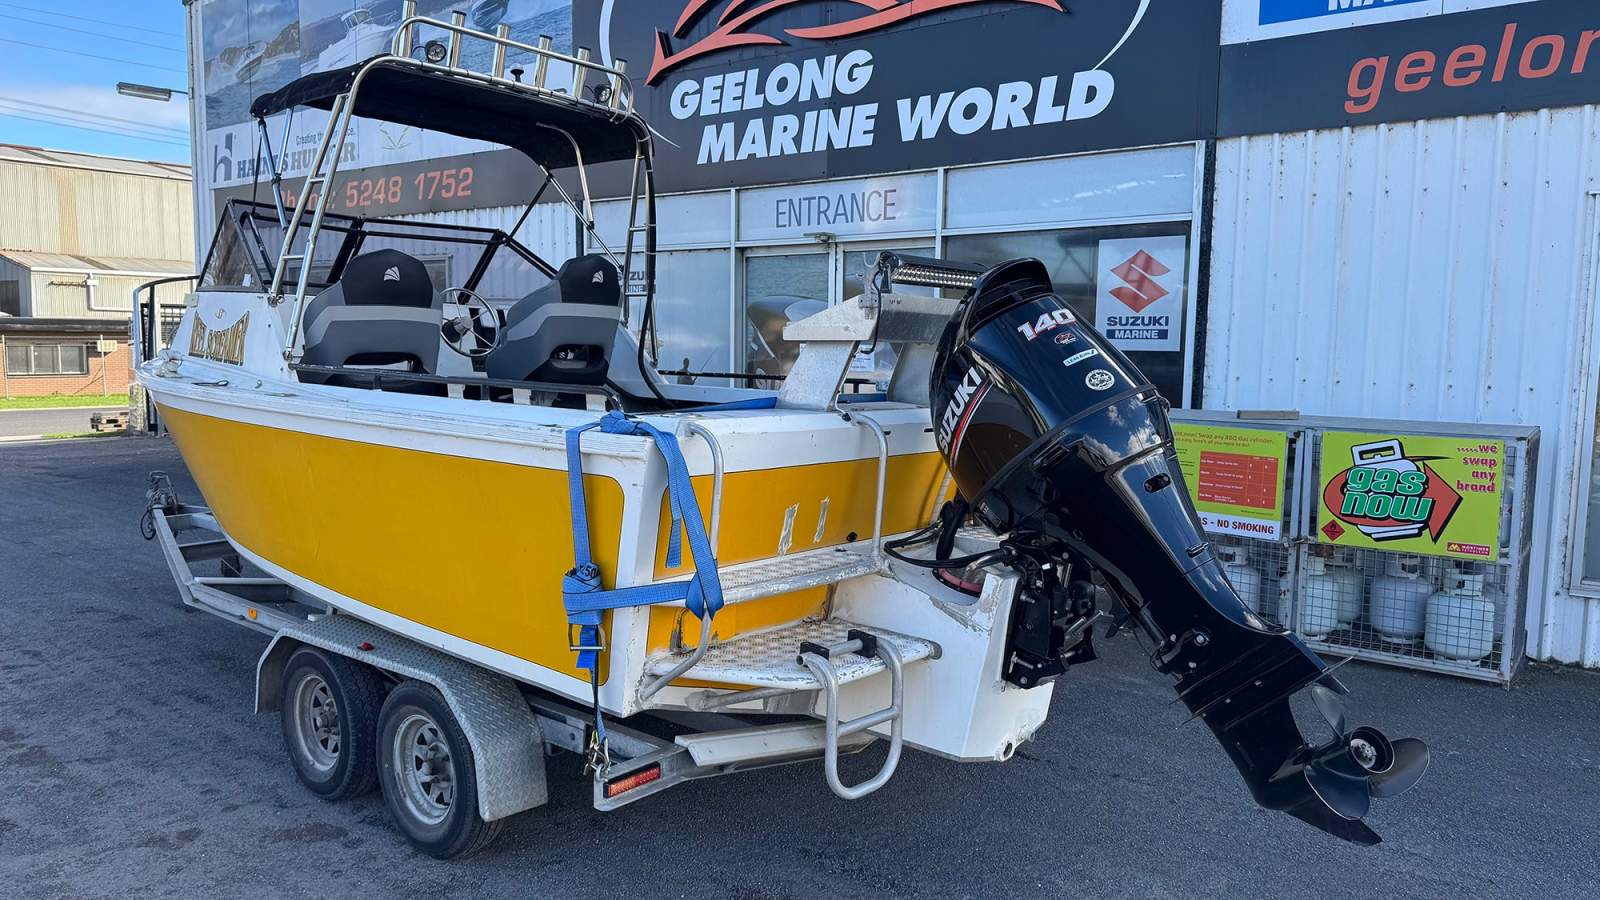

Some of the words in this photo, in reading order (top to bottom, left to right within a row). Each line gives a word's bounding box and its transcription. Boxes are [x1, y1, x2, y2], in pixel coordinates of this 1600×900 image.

[670, 49, 874, 121] GEELONG
[696, 102, 879, 165] MARINE
[896, 69, 1116, 143] WORLD
[345, 175, 402, 209] 5248
[414, 166, 474, 201] 1752
[775, 188, 898, 229] ENTRANCE
[1017, 307, 1077, 342] 140
[1106, 315, 1170, 327] SUZUKI
[1114, 329, 1160, 339] MARINE
[938, 366, 982, 456] SUZUKI
[1462, 456, 1497, 468] swap
[1471, 470, 1496, 483] any
[1346, 466, 1428, 496] gas
[1456, 479, 1496, 493] brand
[1340, 491, 1433, 521] now
[1217, 518, 1230, 529] NO
[1231, 520, 1275, 535] SMOKING
